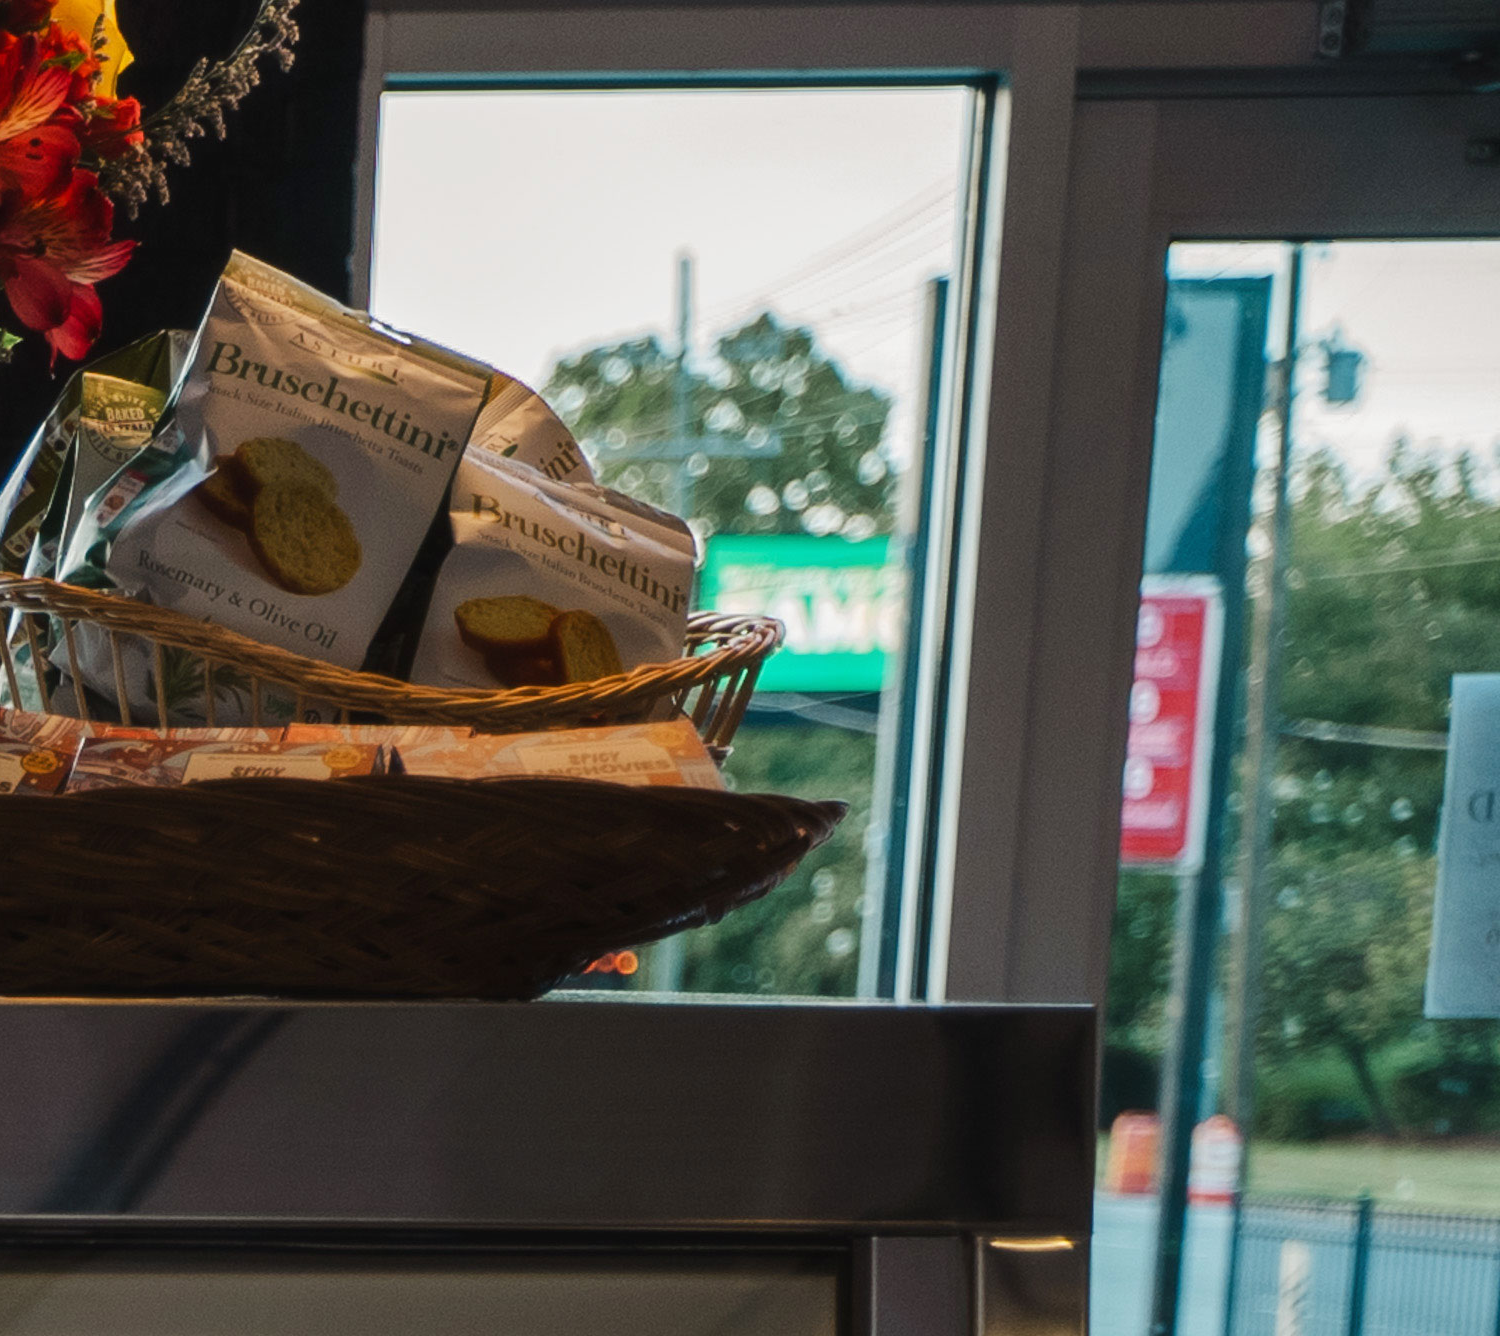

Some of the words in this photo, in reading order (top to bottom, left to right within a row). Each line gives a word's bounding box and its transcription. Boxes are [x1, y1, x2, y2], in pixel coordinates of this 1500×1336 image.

[105, 406, 145, 422] BAKED
[205, 340, 451, 462] Bruschettini
[277, 399, 318, 427] Italian
[386, 447, 425, 475] Toasts
[471, 493, 681, 616] Bruschettini
[137, 549, 226, 602] Rosemary
[228, 588, 242, 607] &
[248, 587, 301, 634] Olive
[303, 622, 339, 650] Oil
[231, 763, 286, 779] SPICY
